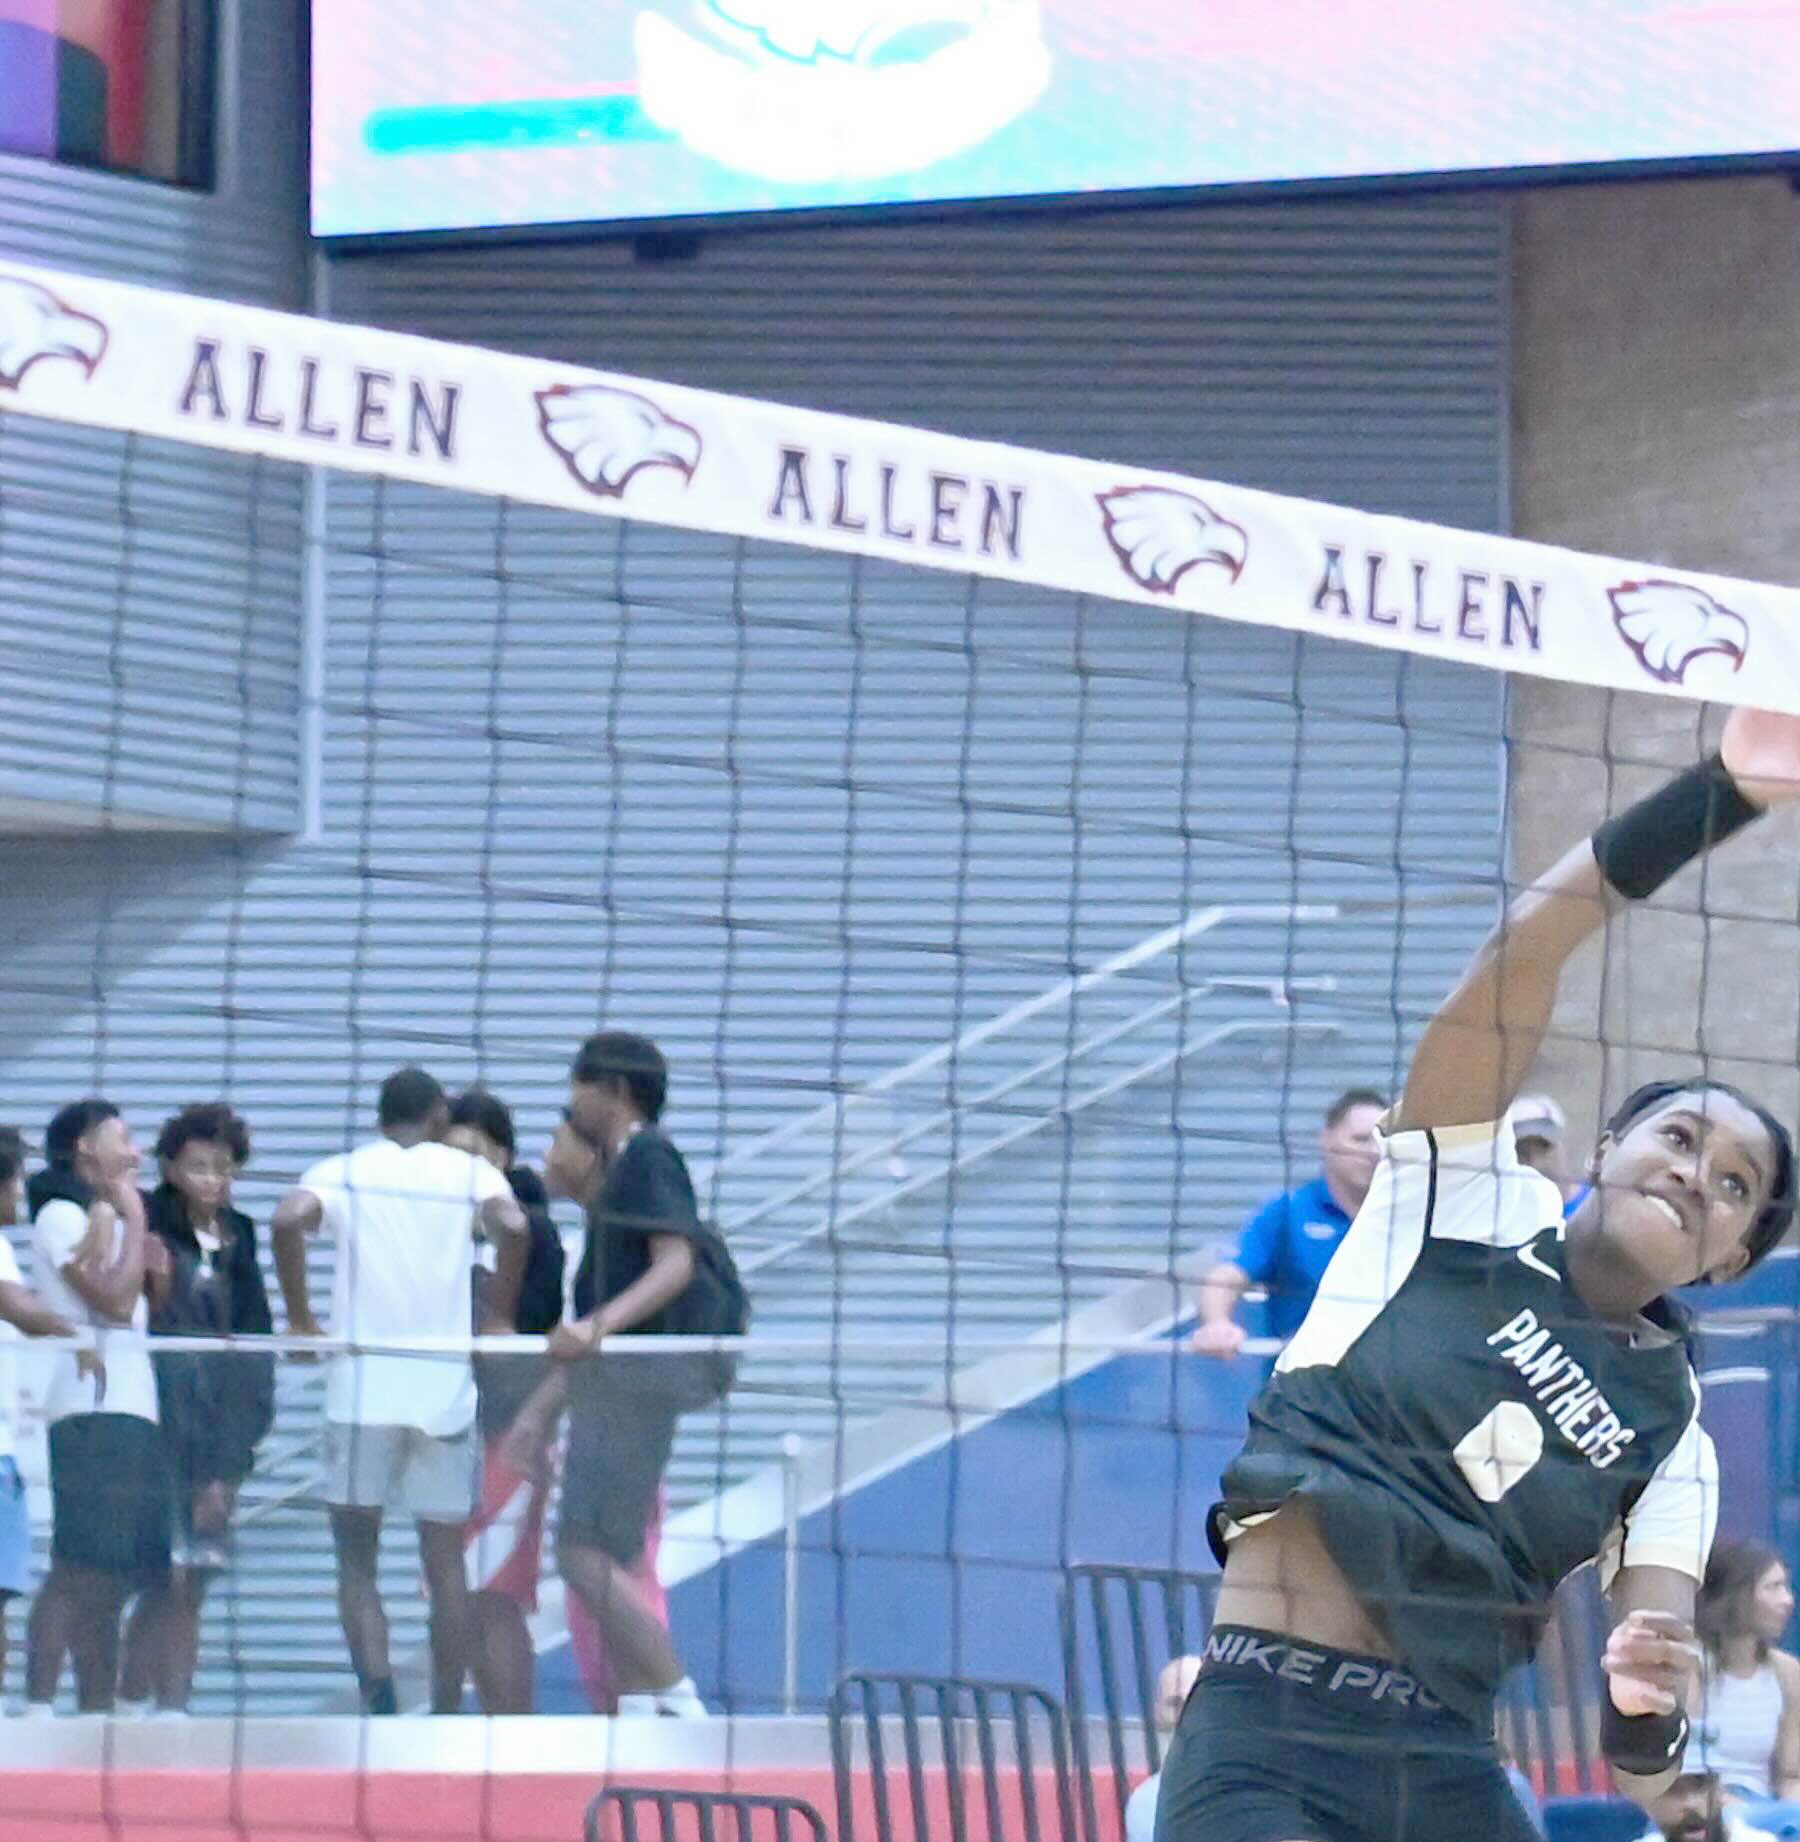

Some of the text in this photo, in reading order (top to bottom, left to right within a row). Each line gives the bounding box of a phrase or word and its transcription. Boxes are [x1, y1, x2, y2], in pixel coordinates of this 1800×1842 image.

[176, 337, 463, 462] ALLEN
[767, 444, 1028, 560] ALLEN
[1310, 543, 1548, 654] ALLEN
[1486, 1308, 1636, 1468] PANTHERS
[1206, 1633, 1327, 1685] NIKE
